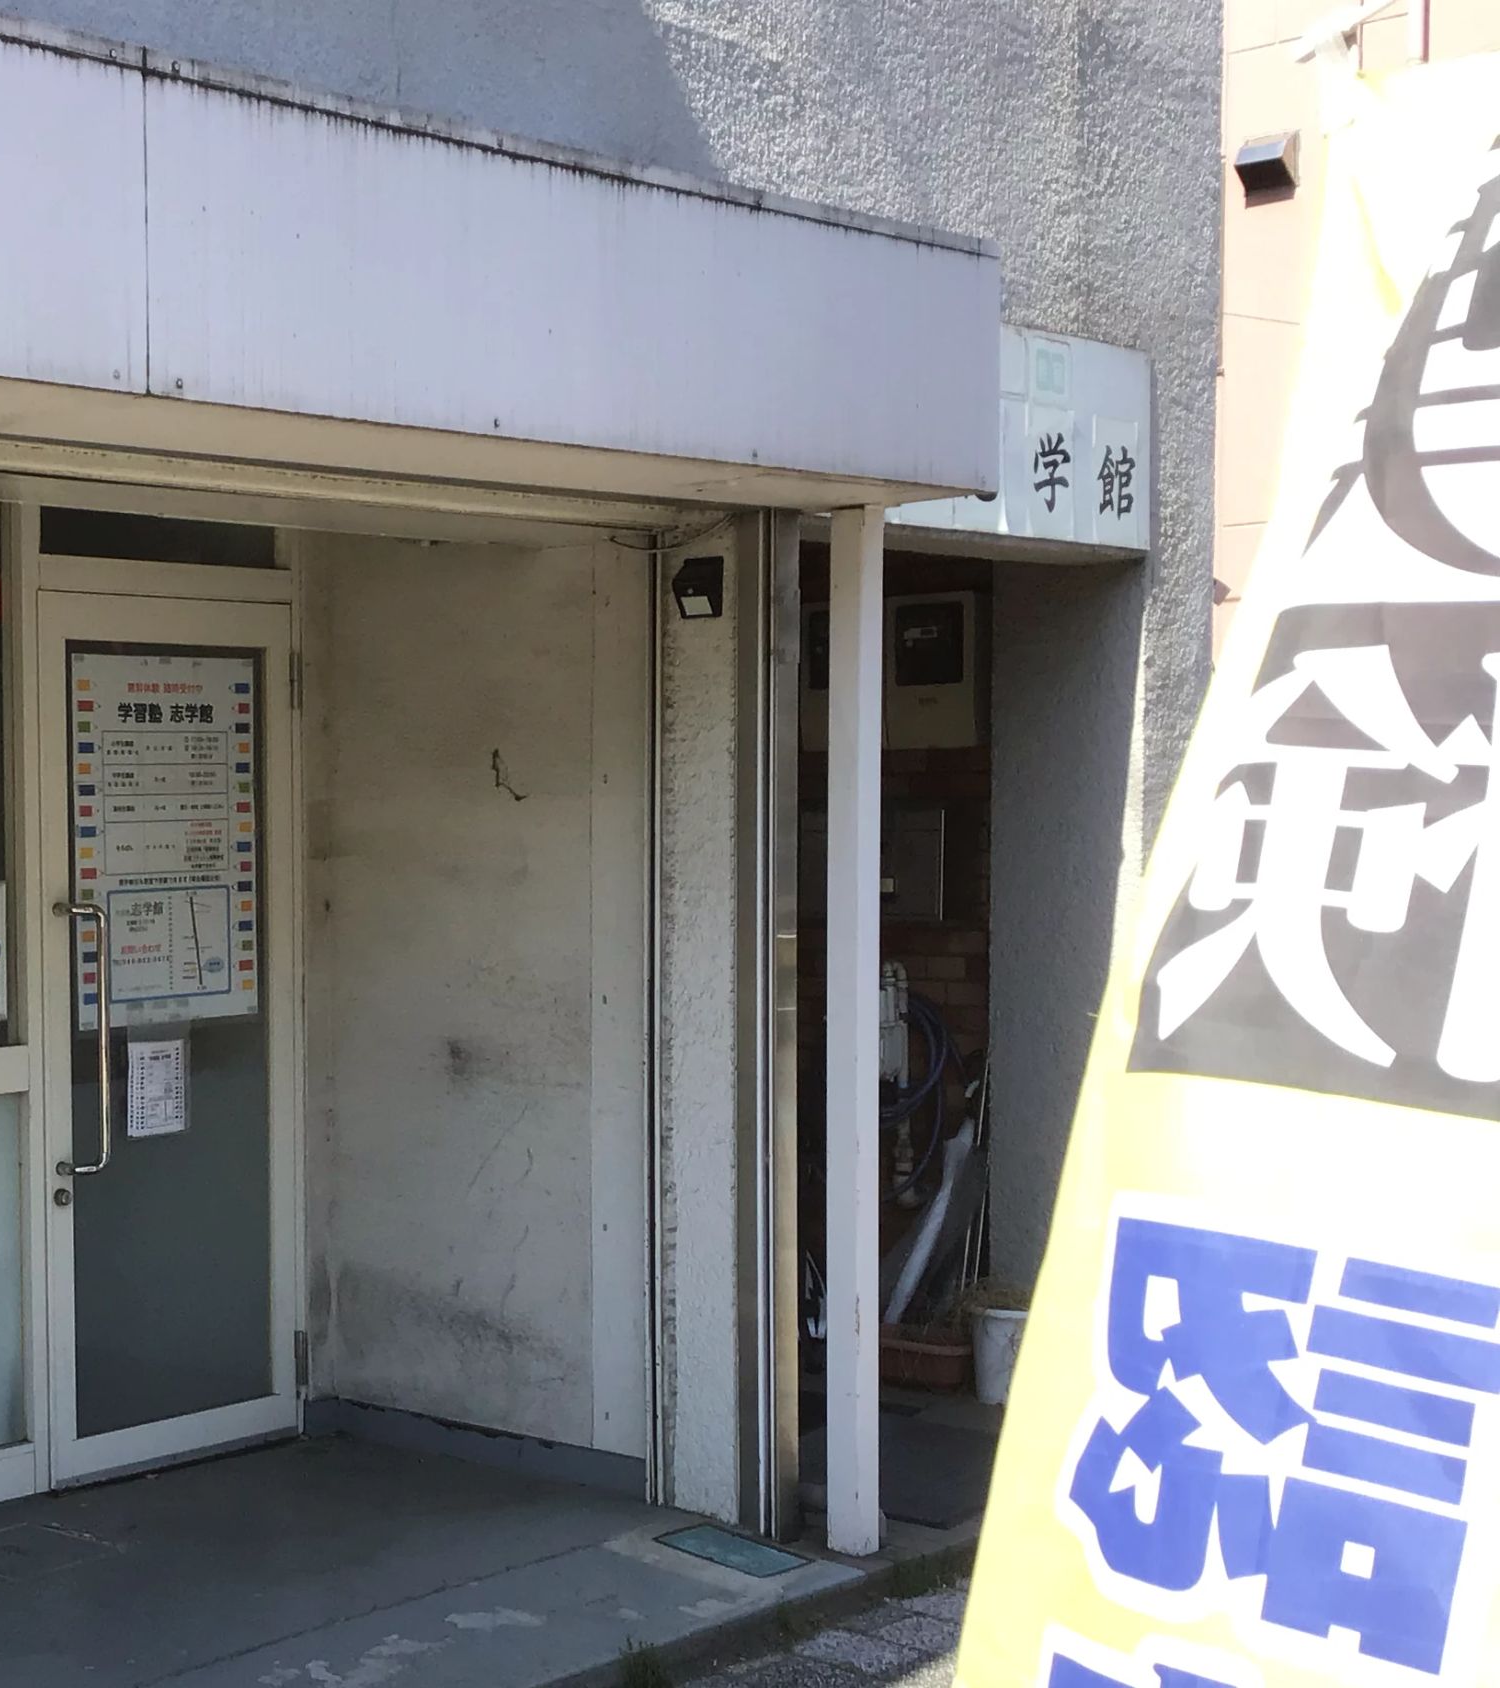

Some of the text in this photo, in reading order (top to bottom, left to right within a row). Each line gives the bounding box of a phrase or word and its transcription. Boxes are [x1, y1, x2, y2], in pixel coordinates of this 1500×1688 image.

[974, 432, 1137, 521] 学館
[117, 702, 214, 724] 学習塾 志学館
